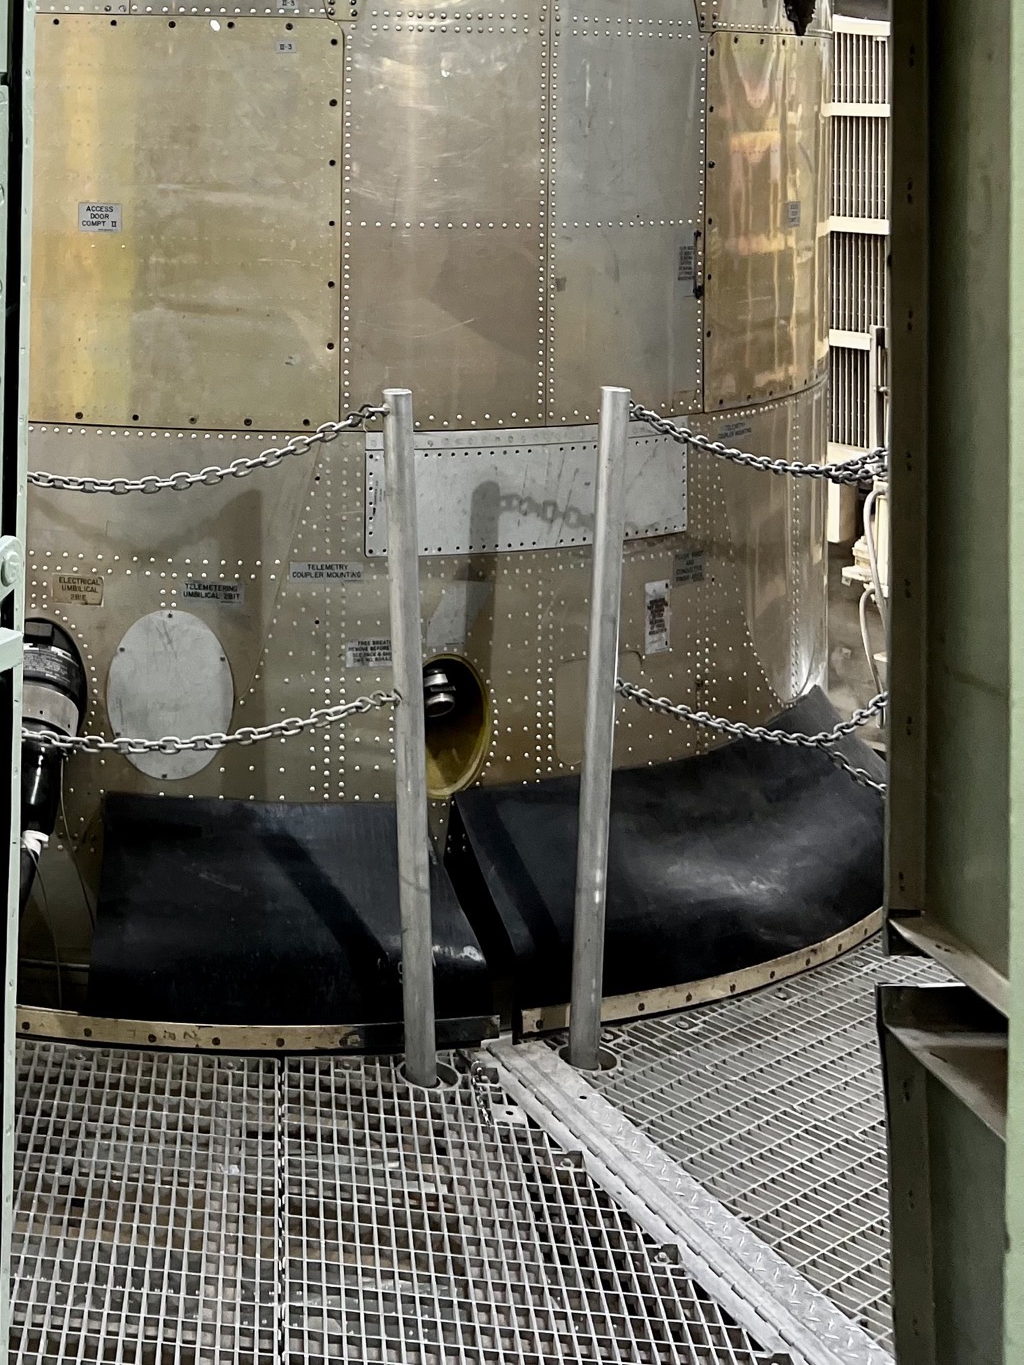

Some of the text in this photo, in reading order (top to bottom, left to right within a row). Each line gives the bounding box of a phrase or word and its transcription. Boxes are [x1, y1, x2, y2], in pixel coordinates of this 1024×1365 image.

[86, 205, 114, 213] ACCESS
[307, 563, 349, 571] TELEMETRY
[292, 571, 362, 579] COUPLER MOUNTING
[59, 576, 100, 586] ELECTRICAL
[61, 584, 99, 593] UMBILICAL
[183, 591, 220, 599] UMBILICAL
